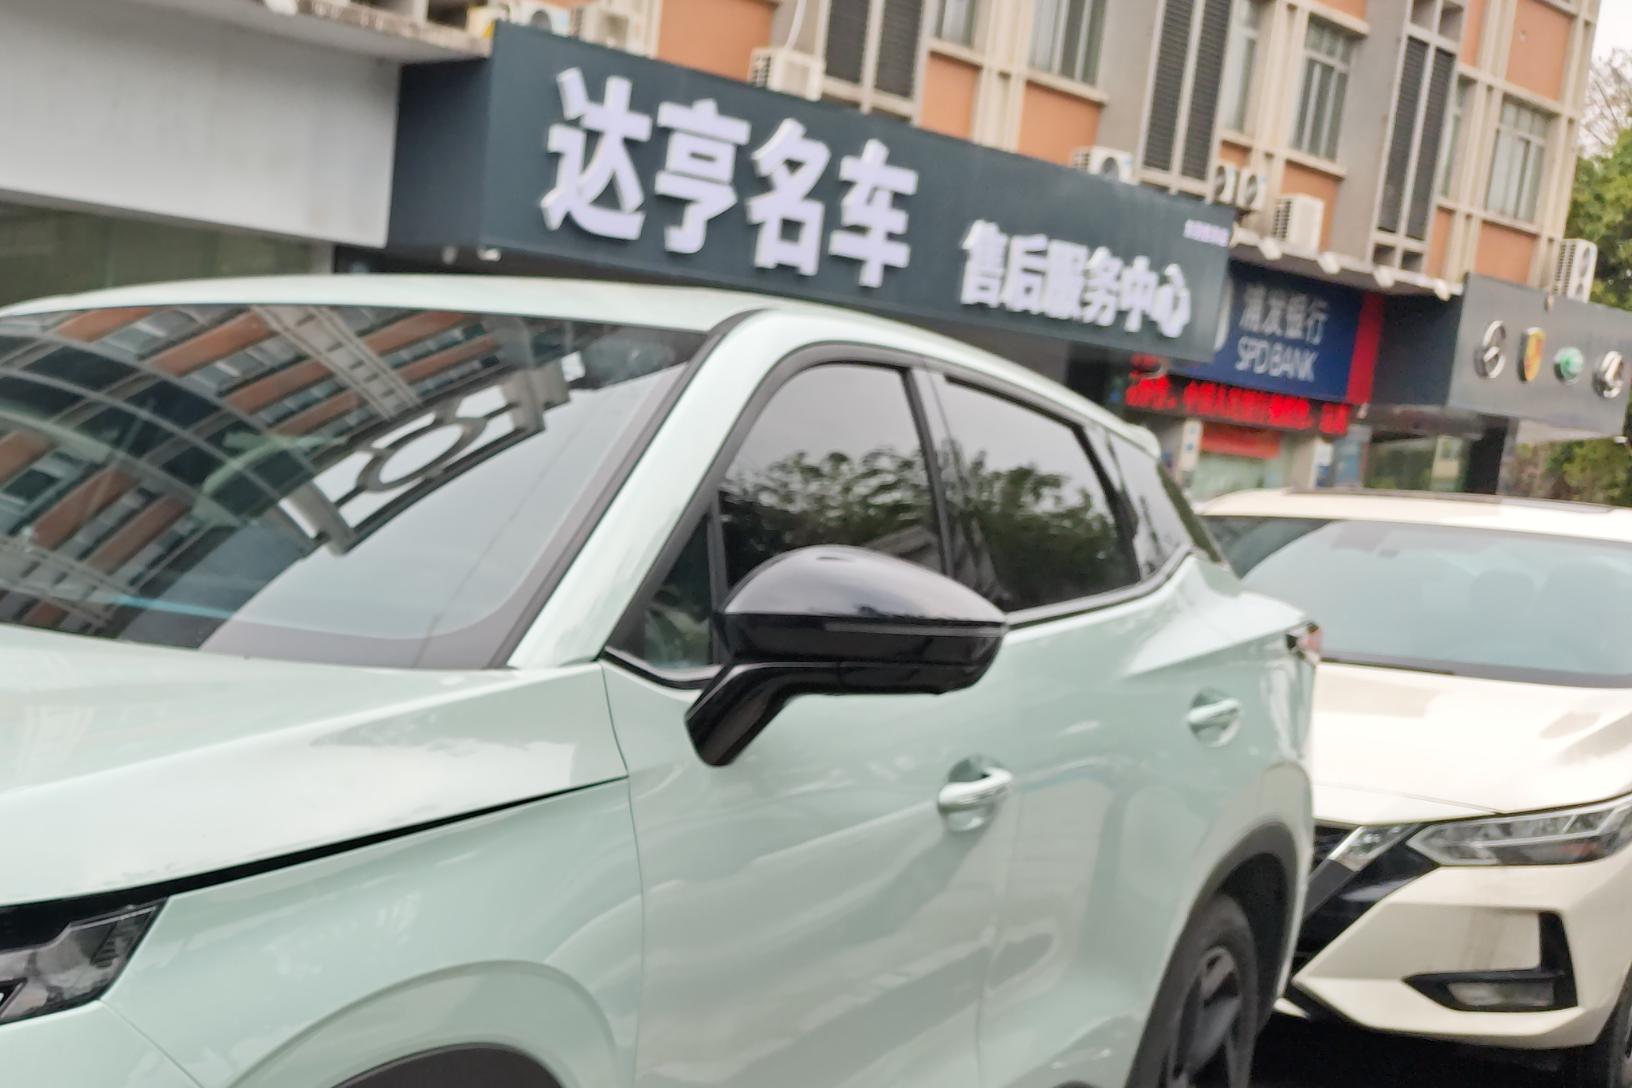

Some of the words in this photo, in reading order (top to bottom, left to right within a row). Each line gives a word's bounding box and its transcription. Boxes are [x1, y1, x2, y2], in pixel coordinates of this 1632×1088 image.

[540, 67, 918, 288] 达亨名车
[960, 219, 1191, 338] 售后服务中心
[1269, 341, 1319, 382] BANK
